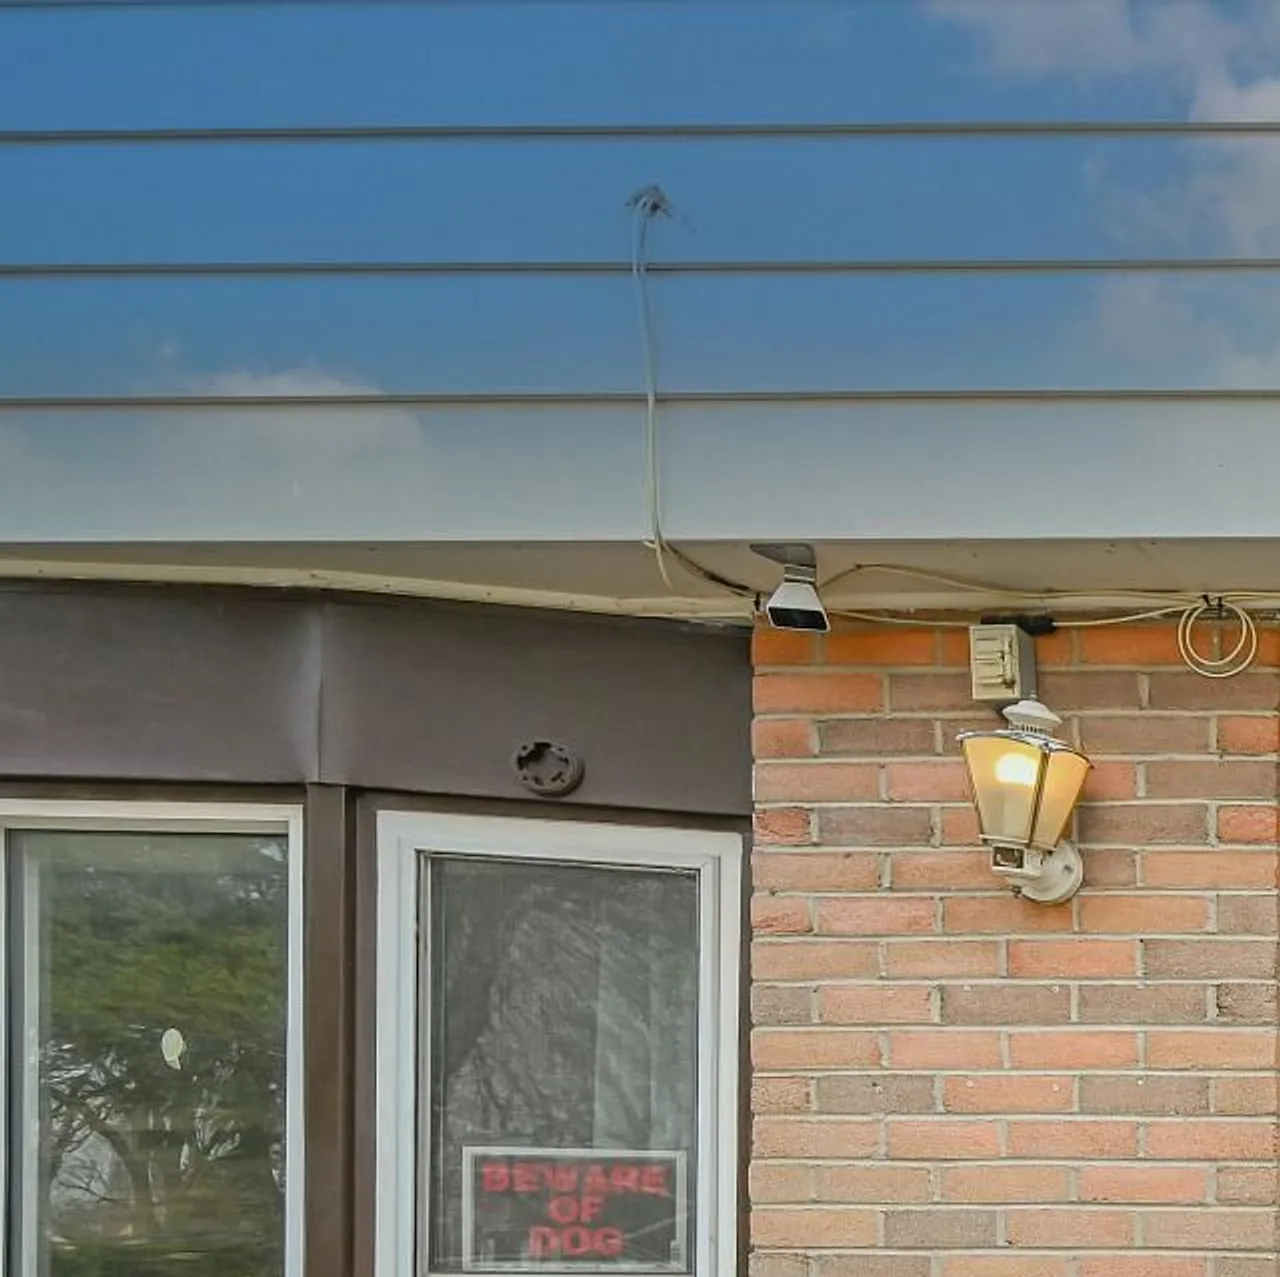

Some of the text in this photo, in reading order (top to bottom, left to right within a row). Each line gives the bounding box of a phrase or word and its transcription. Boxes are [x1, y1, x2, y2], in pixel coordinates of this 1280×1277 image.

[483, 1163, 669, 1195] BEWARE
[549, 1194, 606, 1224] OF
[529, 1225, 624, 1258] DOG
